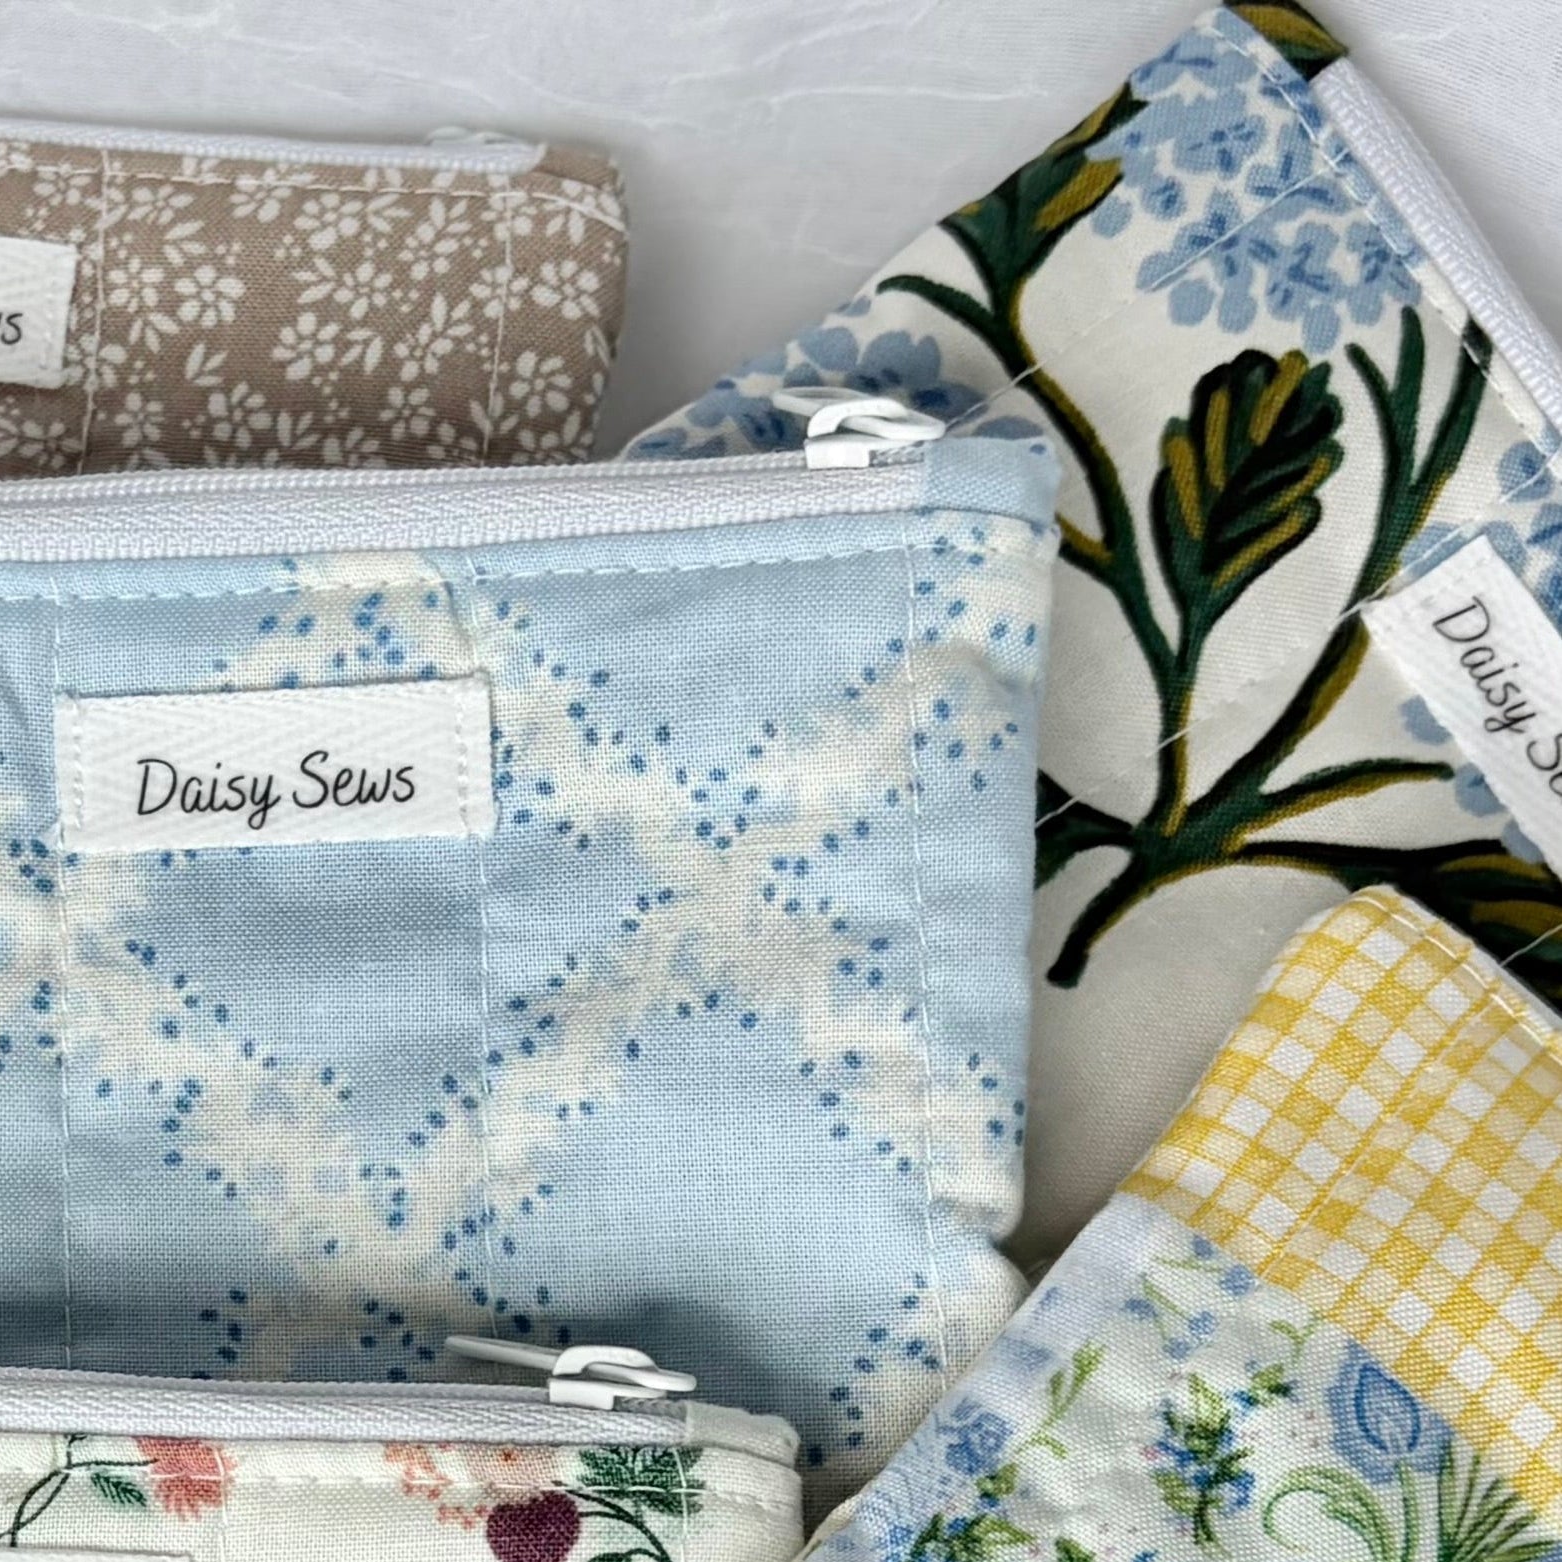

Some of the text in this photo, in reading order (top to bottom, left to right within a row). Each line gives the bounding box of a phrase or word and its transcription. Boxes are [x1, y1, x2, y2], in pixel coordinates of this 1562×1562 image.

[1432, 596, 1536, 733] Daisy
[137, 750, 415, 830] Daisy Sews
